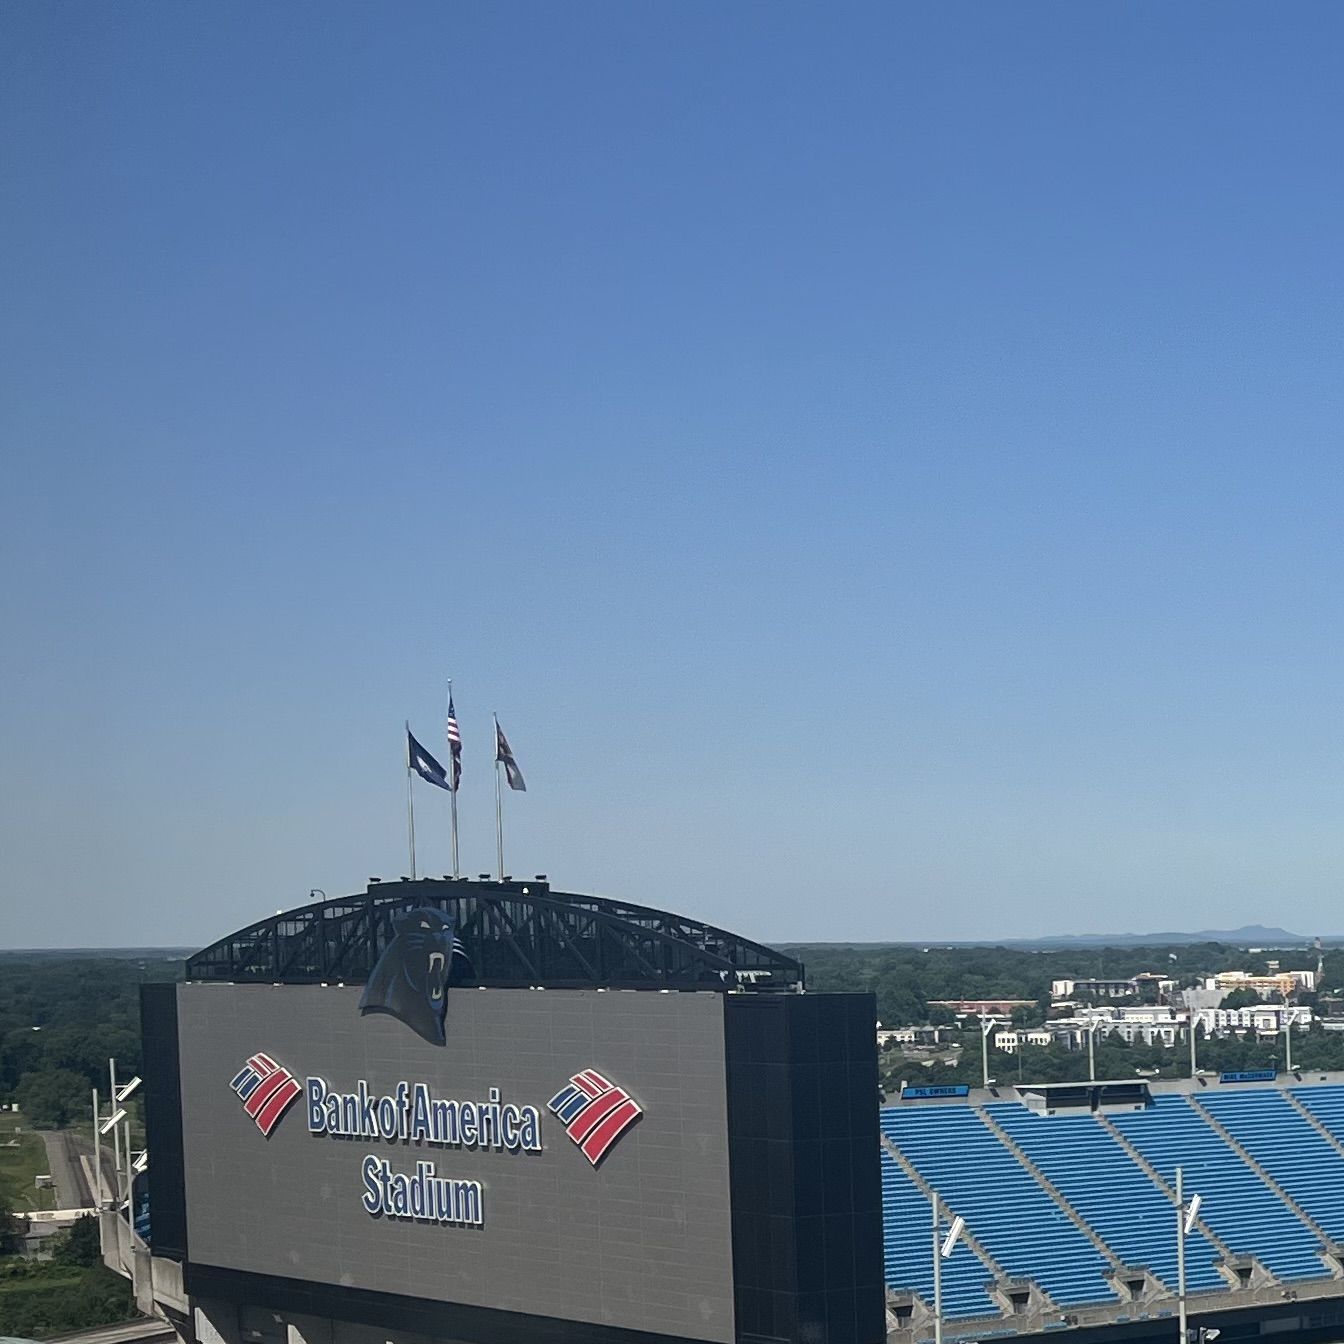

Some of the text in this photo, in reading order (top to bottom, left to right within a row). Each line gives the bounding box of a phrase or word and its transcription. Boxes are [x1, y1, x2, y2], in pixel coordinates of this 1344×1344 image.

[306, 1076, 542, 1151] Bank of America
[362, 1154, 484, 1225] Stadium
